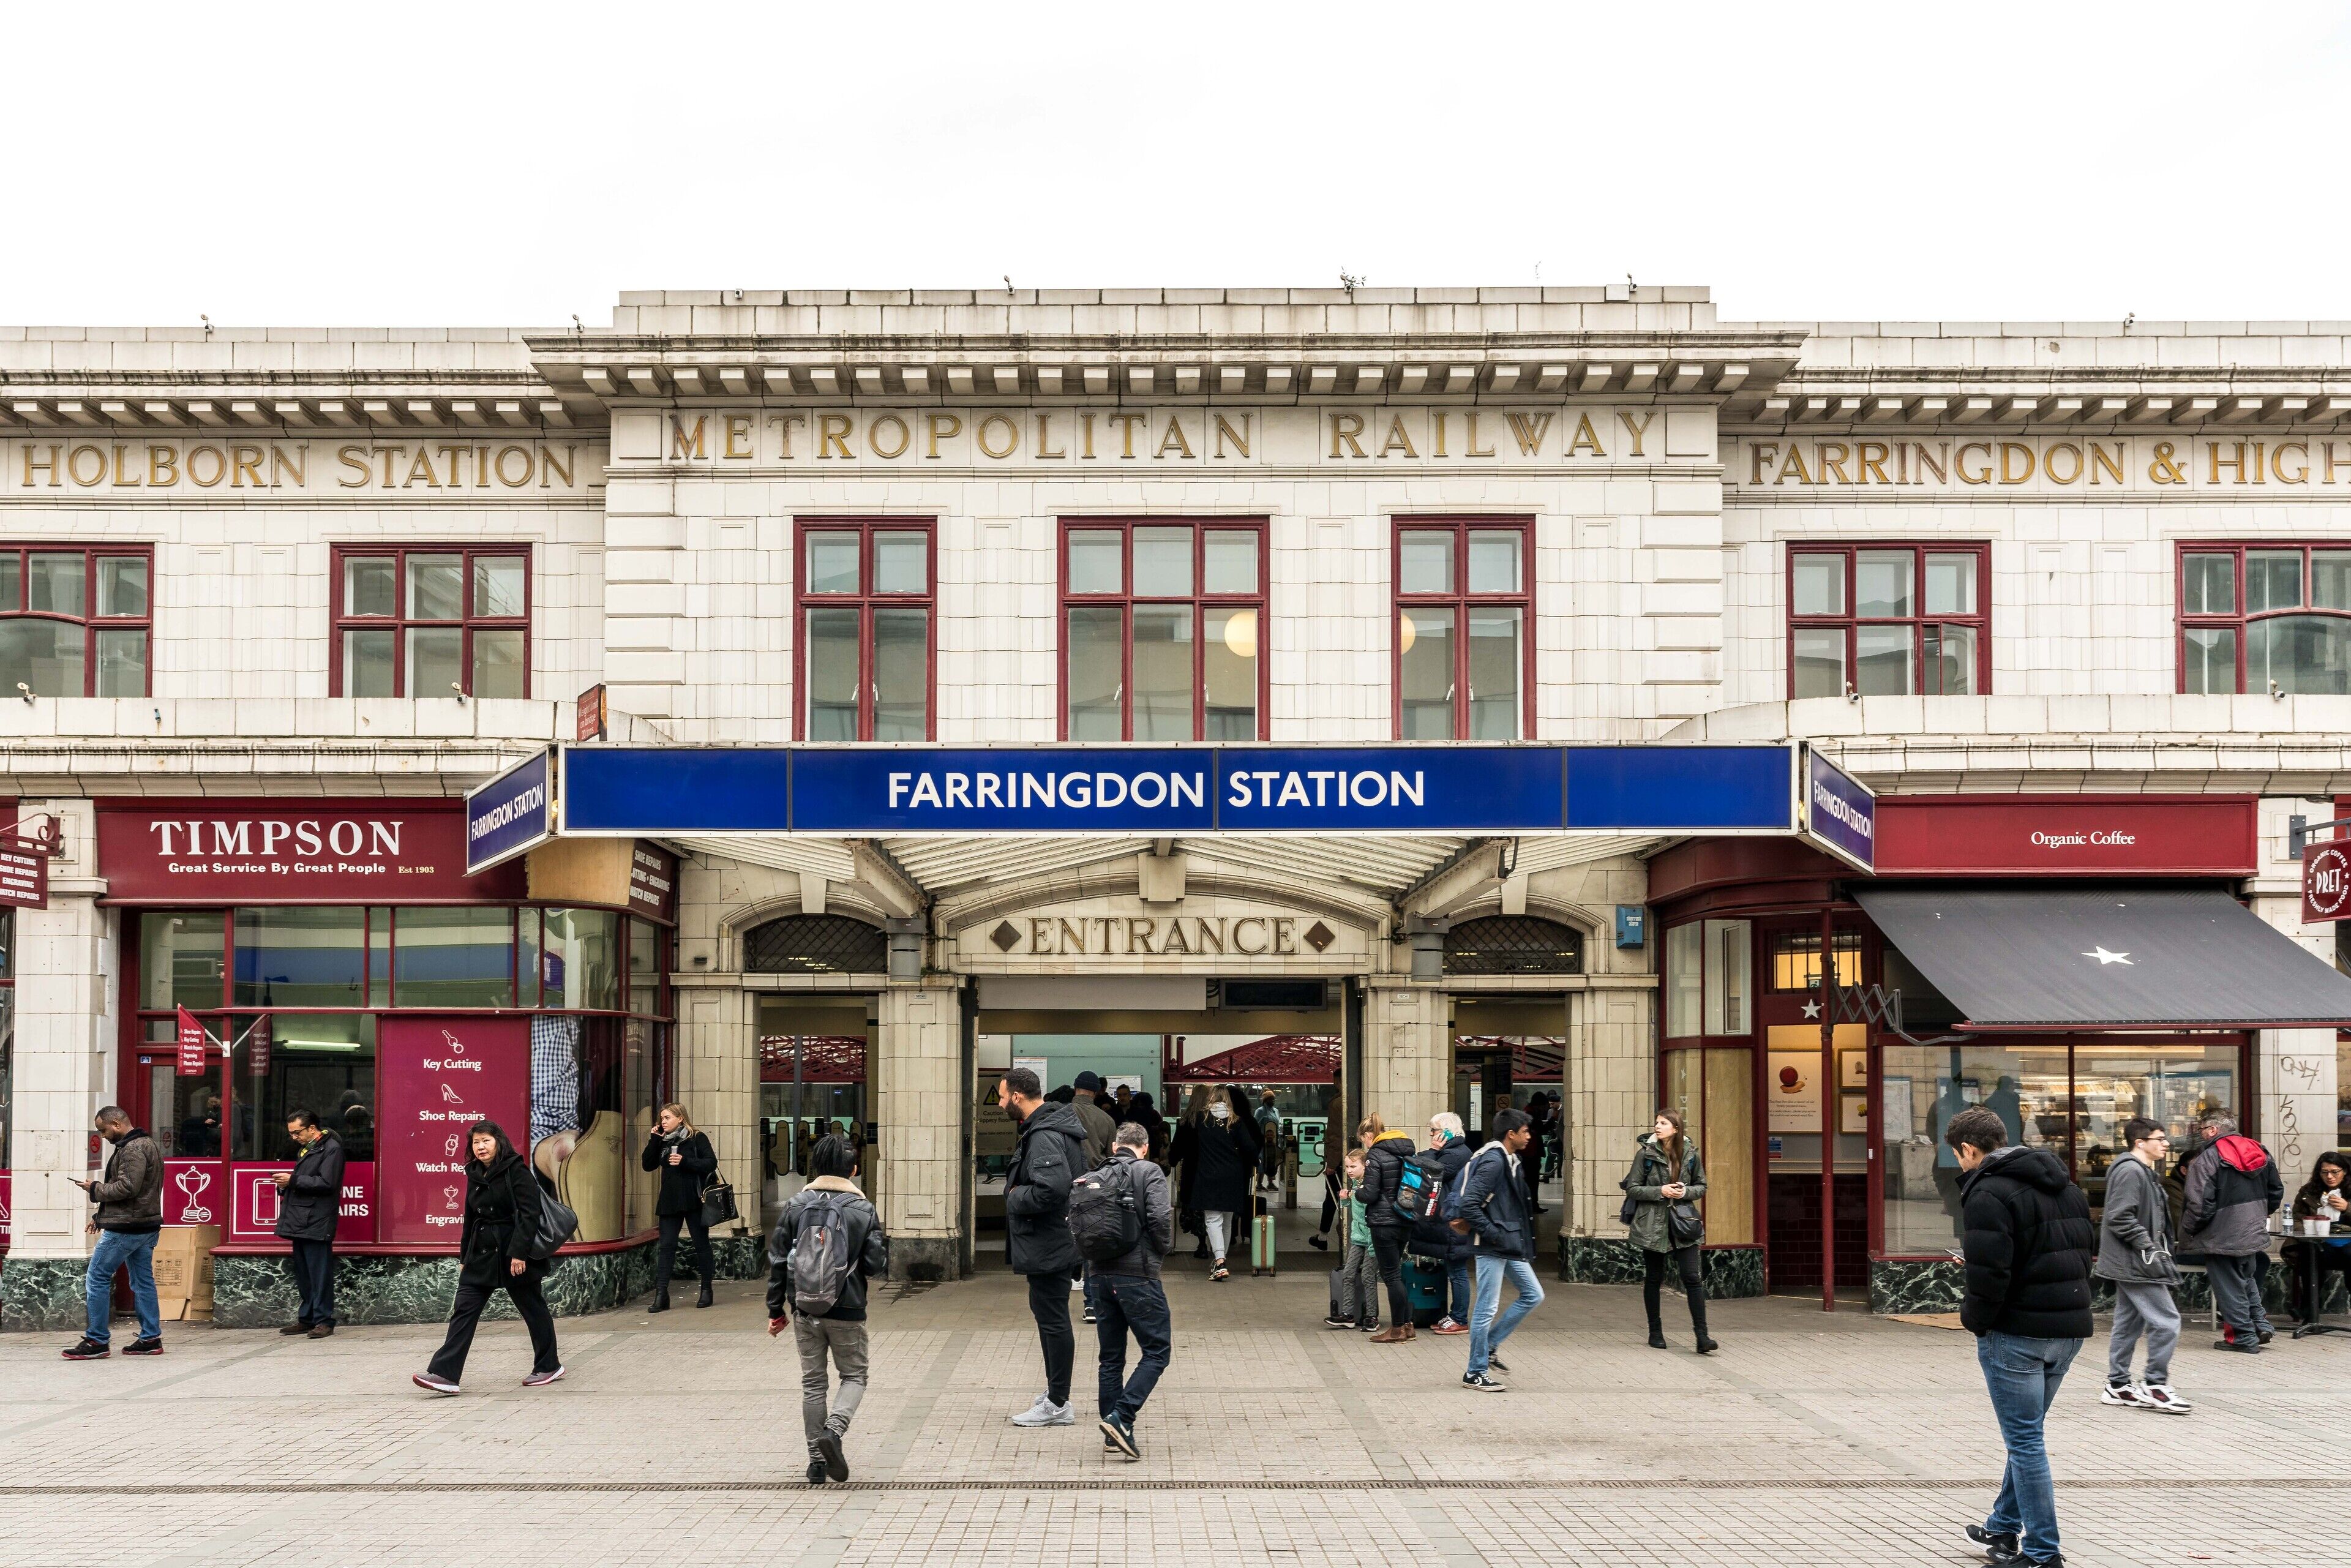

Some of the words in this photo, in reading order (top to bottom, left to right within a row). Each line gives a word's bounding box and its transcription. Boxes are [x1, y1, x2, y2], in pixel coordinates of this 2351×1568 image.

[669, 413, 1253, 459] METROPOLITAN
[1328, 411, 1657, 458] RAILWAY
[22, 444, 306, 487] HOLBORN
[337, 445, 576, 488] STATION
[1749, 441, 2124, 484] FARRINGDON
[2148, 441, 2188, 484] &
[2207, 441, 2351, 484] HIGH
[889, 771, 1204, 808] FARRINGDON
[1228, 770, 1424, 808] STATION
[471, 800, 512, 841] FARRINGDON
[514, 782, 543, 819] STATION
[1814, 780, 1850, 826] FARRINGDON
[1850, 807, 1872, 840] STATION
[150, 820, 403, 856] TIMPSON
[2031, 831, 2087, 849] Organic
[2090, 830, 2135, 845] Coffee
[13, 856, 36, 866] CUTTING
[168, 862, 208, 873] Great
[212, 862, 266, 873] Service
[271, 862, 290, 875] By
[294, 862, 334, 873] Great
[339, 863, 386, 875] People
[634, 850, 645, 863] SHOE
[645, 855, 661, 870] REPAIRS
[2309, 850, 2330, 873] ORGANIC
[2330, 849, 2348, 868] COFFEE
[15, 868, 38, 877] REPAIRS
[398, 866, 413, 874] Est
[414, 866, 435, 874] 1903
[631, 868, 647, 882] UTTING
[649, 875, 670, 891] ENGRAVING
[2, 877, 34, 888] ENGRAVING
[2316, 868, 2341, 894] PRET
[17, 891, 40, 901] REPAIRS
[643, 890, 659, 906] REPAIRS
[2308, 890, 2324, 913] FRESHLY
[2324, 902, 2340, 913] MADE
[2338, 885, 2349, 904] FOOD
[1027, 917, 1296, 955] ENTRANCE
[423, 1059, 441, 1071] Key
[443, 1058, 482, 1071] Cutting
[419, 1109, 446, 1120] Shoe
[448, 1110, 486, 1123] Repairs
[415, 1161, 448, 1172] Watch
[339, 1204, 369, 1216] AIRS
[426, 1214, 464, 1227] Engravi
